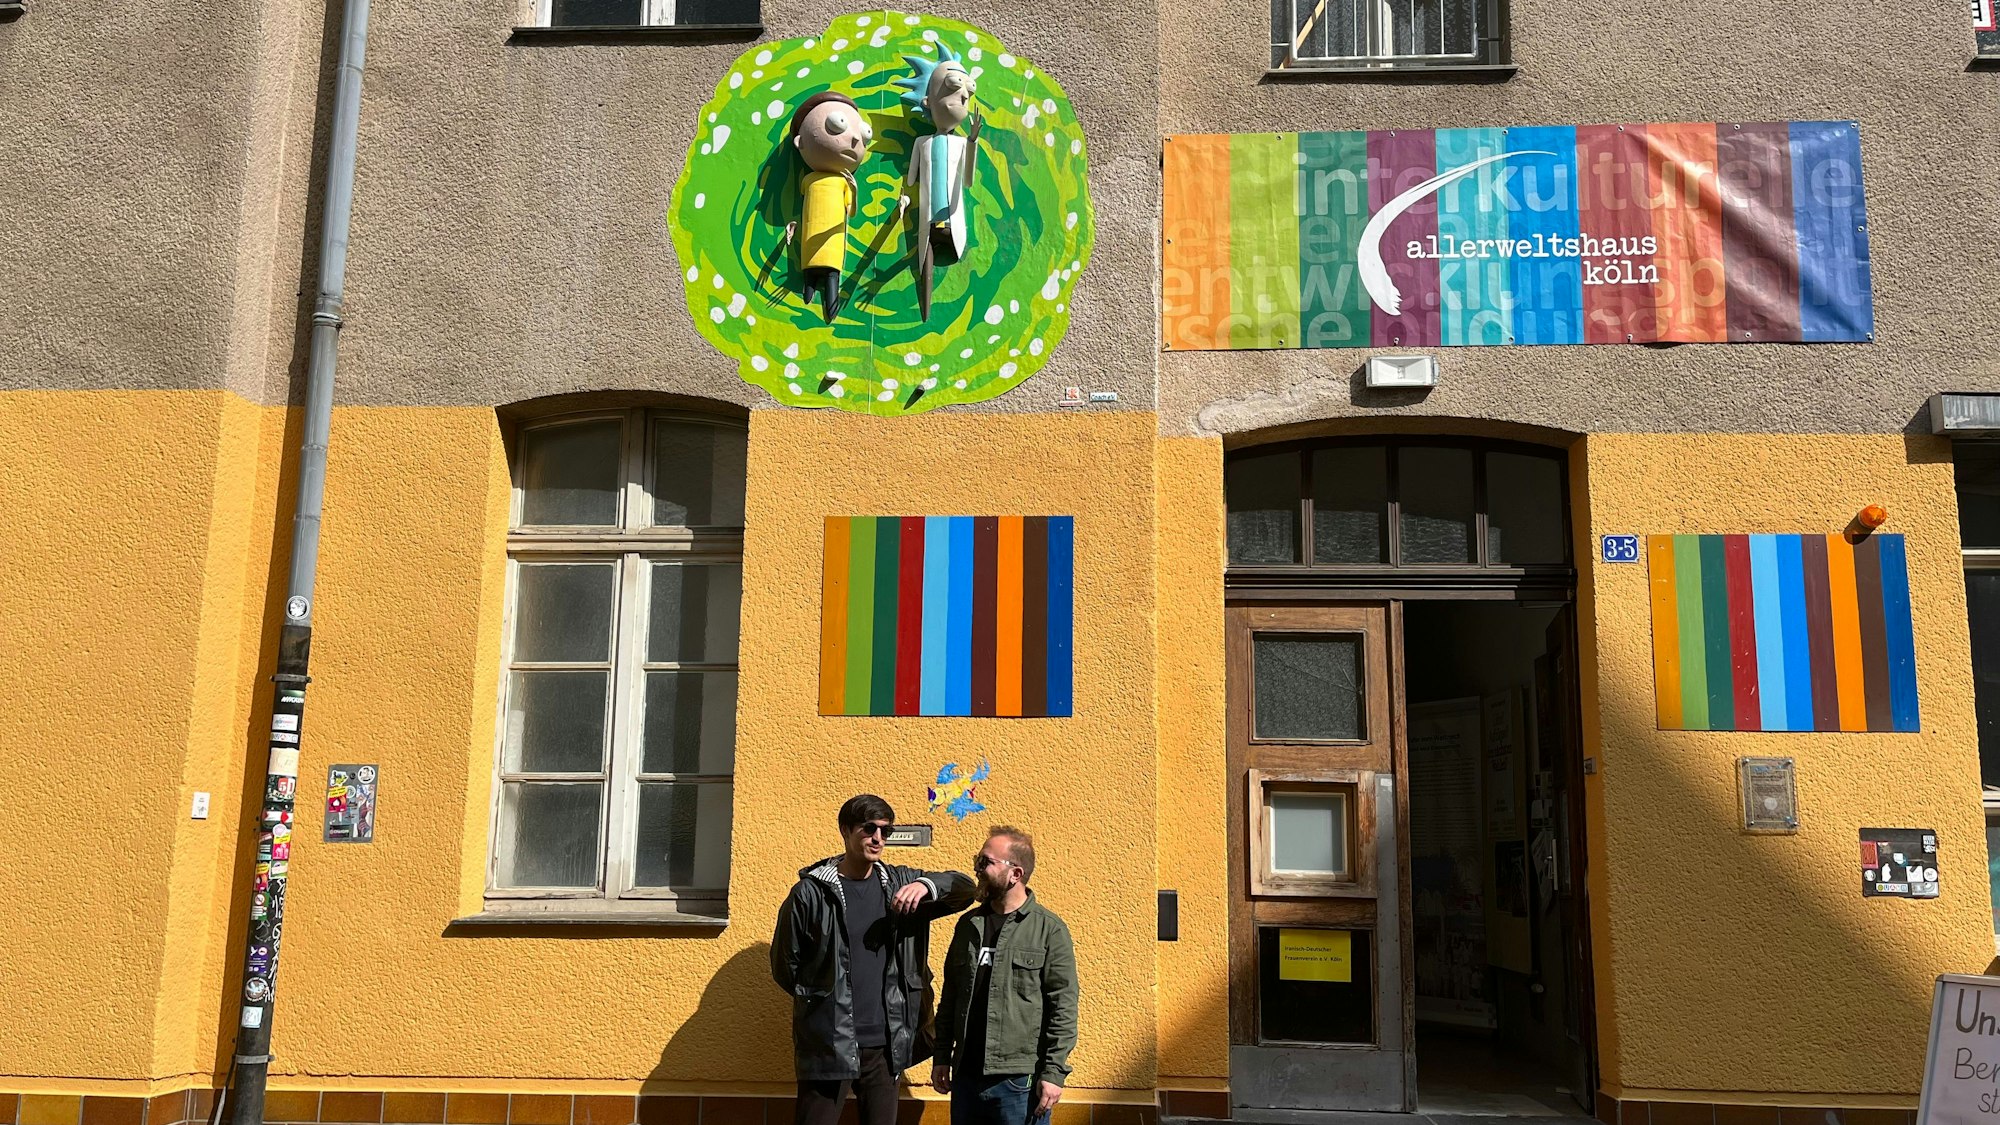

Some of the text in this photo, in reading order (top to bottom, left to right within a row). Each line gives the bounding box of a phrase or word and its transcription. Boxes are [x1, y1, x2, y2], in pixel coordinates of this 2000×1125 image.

[1406, 233, 1658, 259] allerweltshaus
[1583, 259, 1659, 285] köln
[1607, 539, 1635, 558] 3-5
[1956, 988, 2000, 1036] Un
